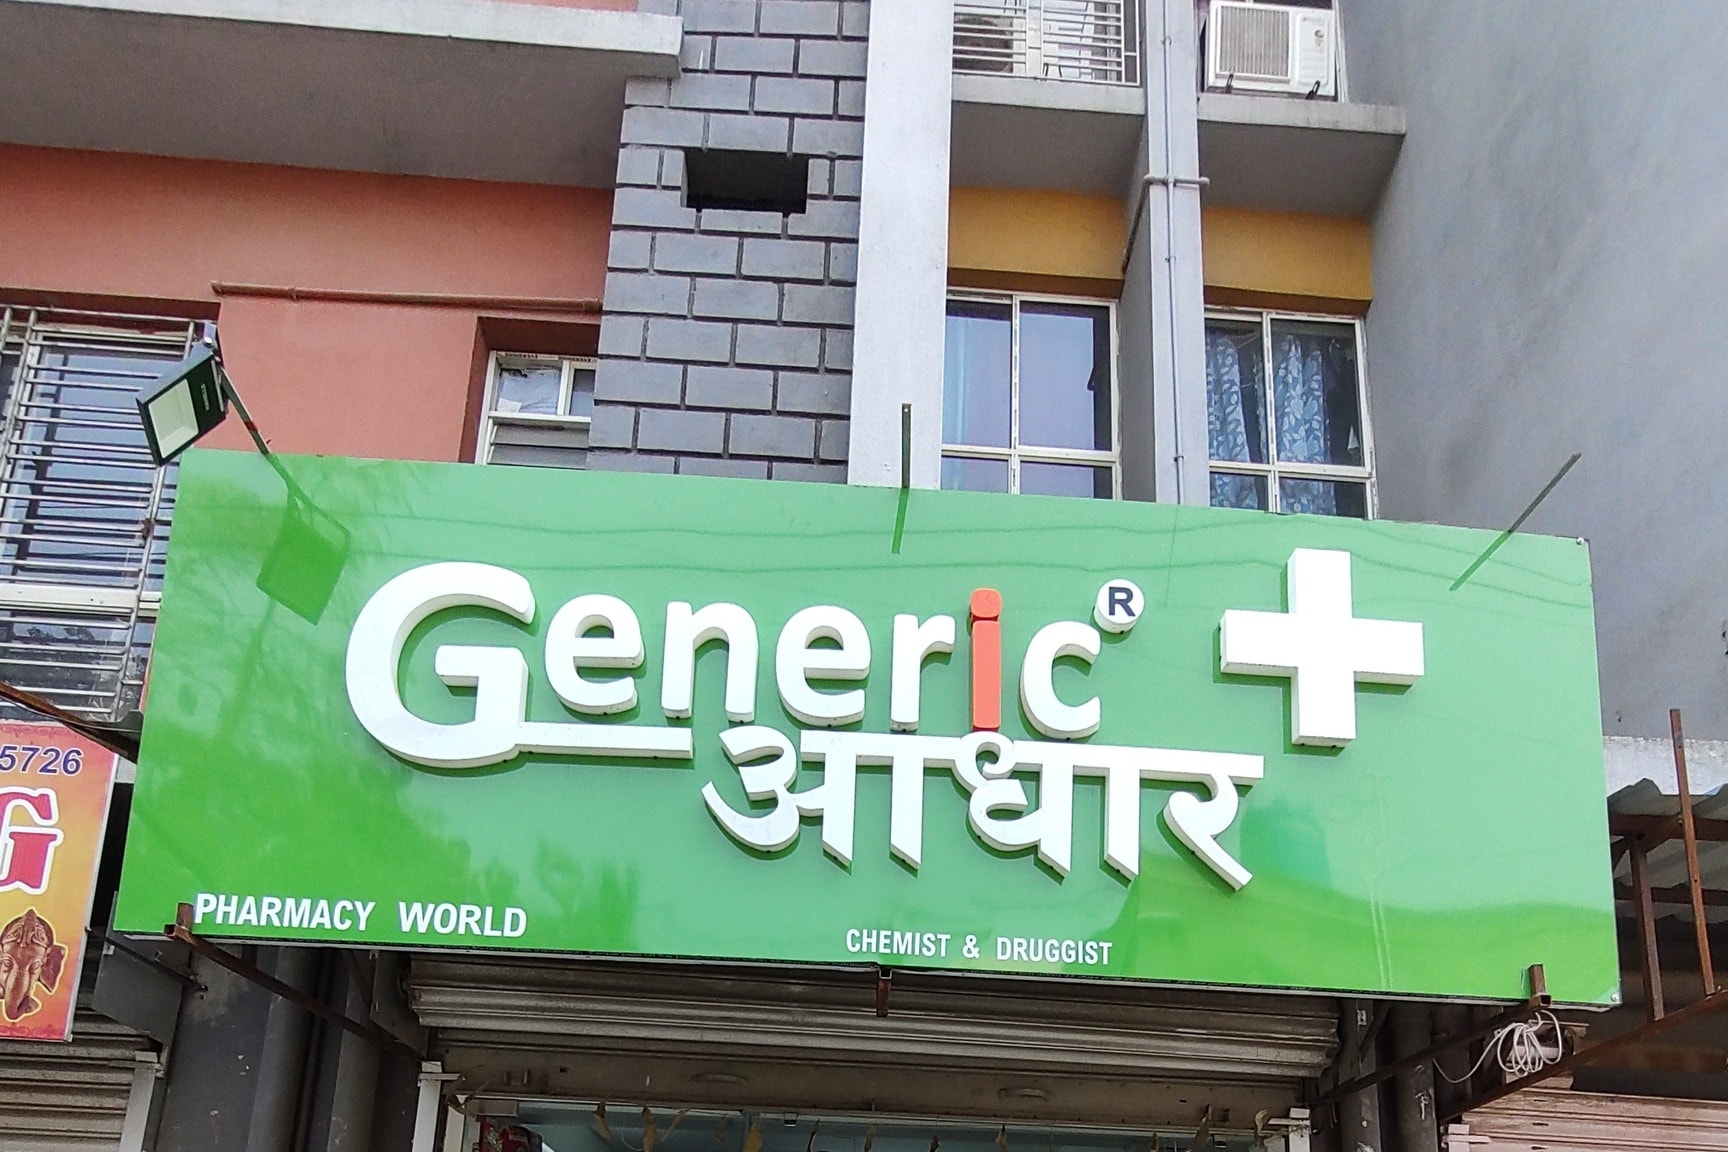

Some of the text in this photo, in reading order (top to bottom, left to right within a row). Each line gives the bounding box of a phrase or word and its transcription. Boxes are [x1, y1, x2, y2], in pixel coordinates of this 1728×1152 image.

[345, 561, 1101, 769] Generic
[0, 745, 82, 776] 5726
[701, 725, 1265, 892] आधार
[194, 891, 528, 938] PHARMACY WORLD
[845, 928, 1113, 966] CHEMIST & DRUGGIST
